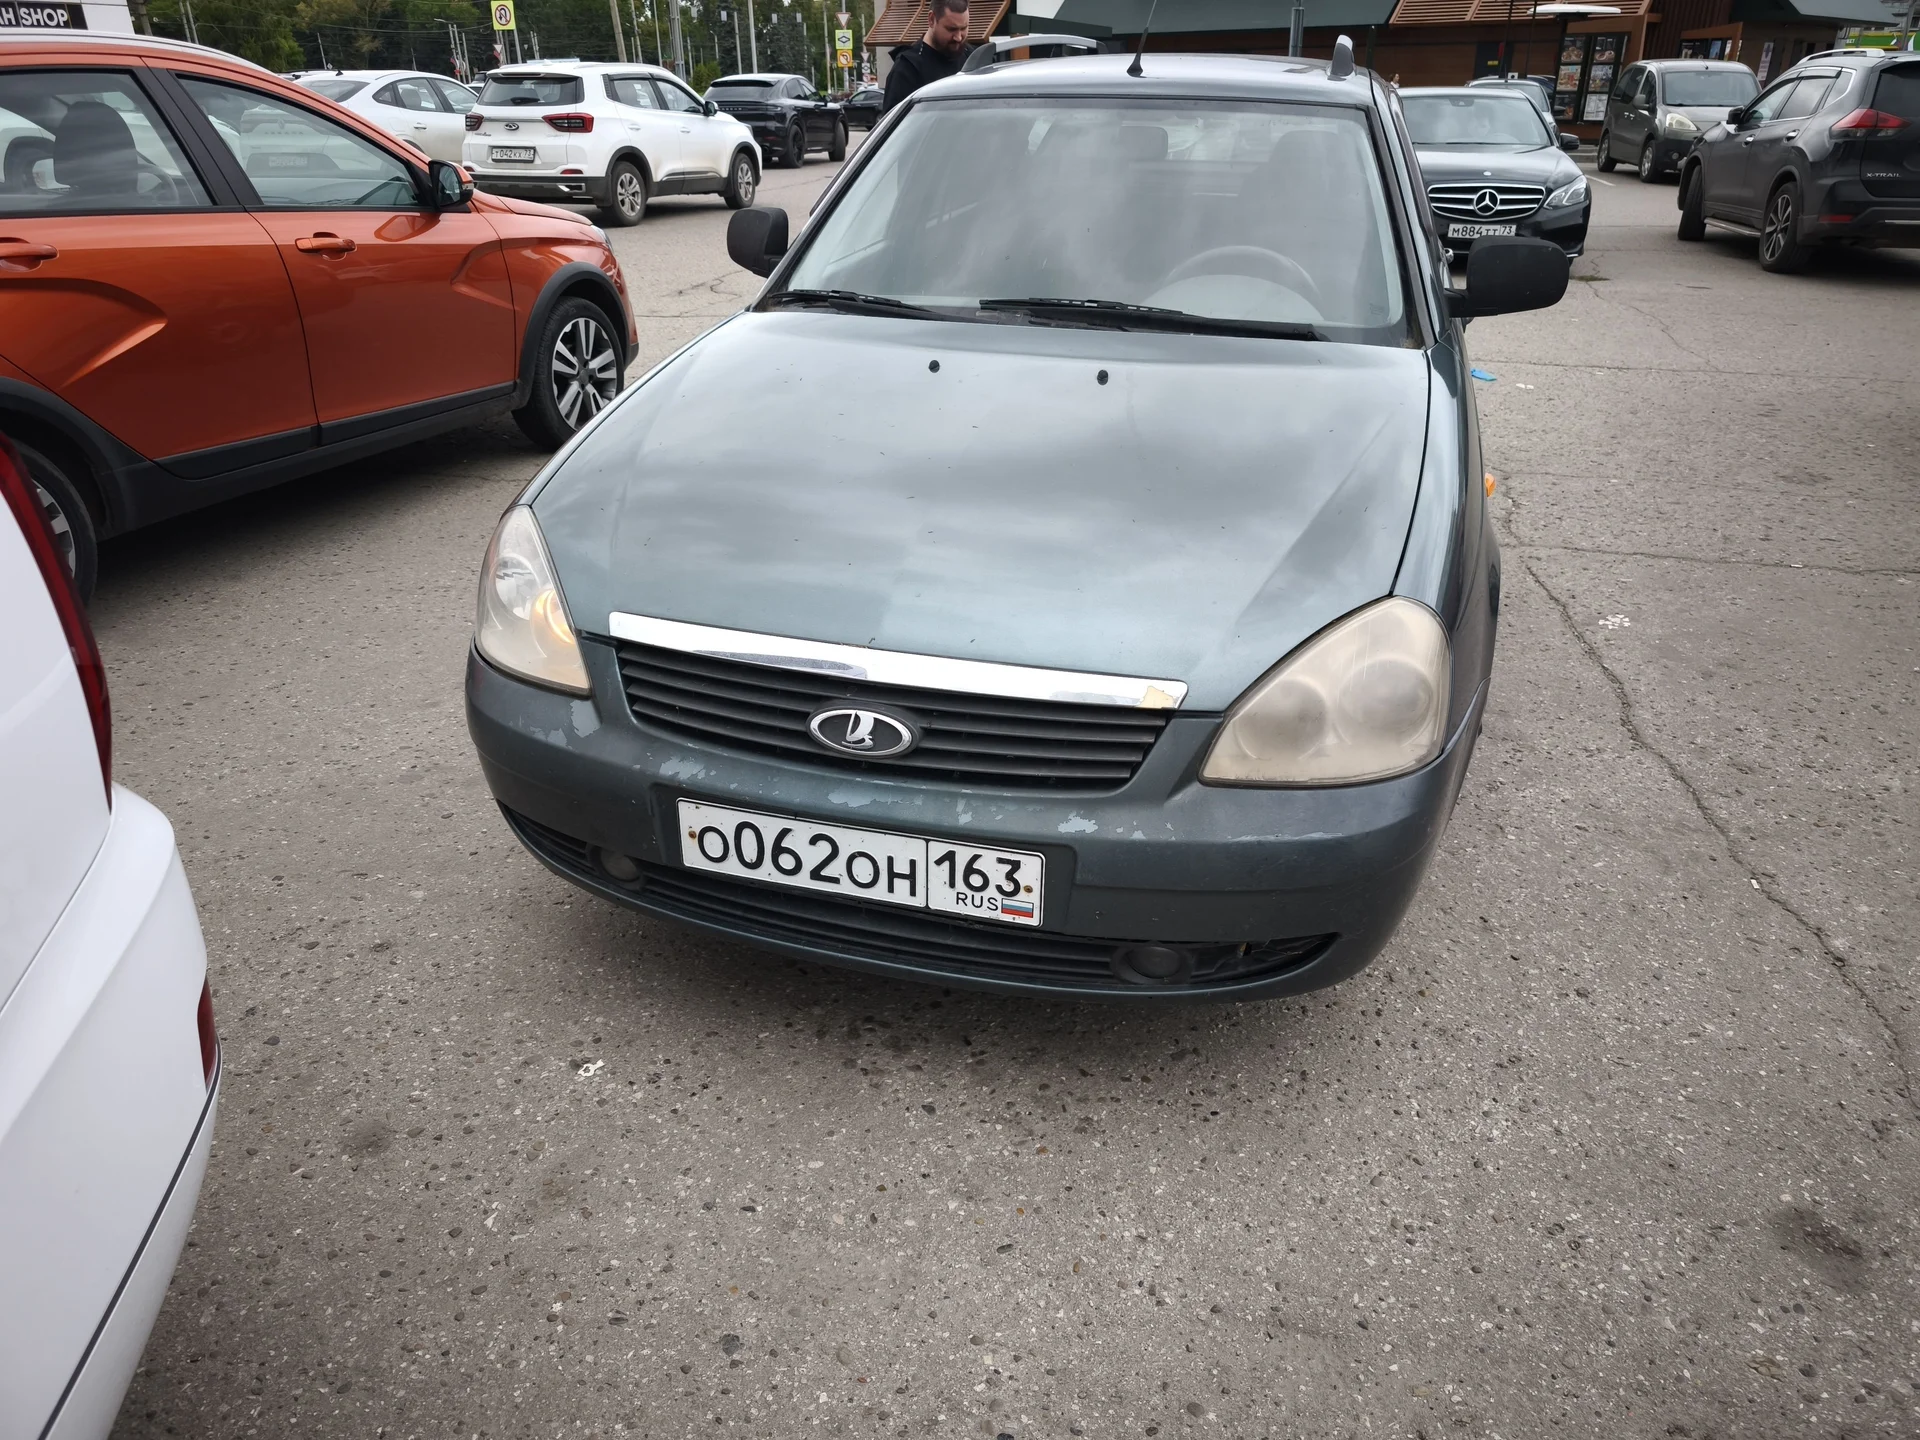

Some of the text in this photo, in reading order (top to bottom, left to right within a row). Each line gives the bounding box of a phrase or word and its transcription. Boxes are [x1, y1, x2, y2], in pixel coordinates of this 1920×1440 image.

[20, 8, 68, 27] SHOP
[1502, 225, 1512, 234] 73
[698, 820, 1022, 898] О062ОН 163
[955, 892, 999, 912] RUS
